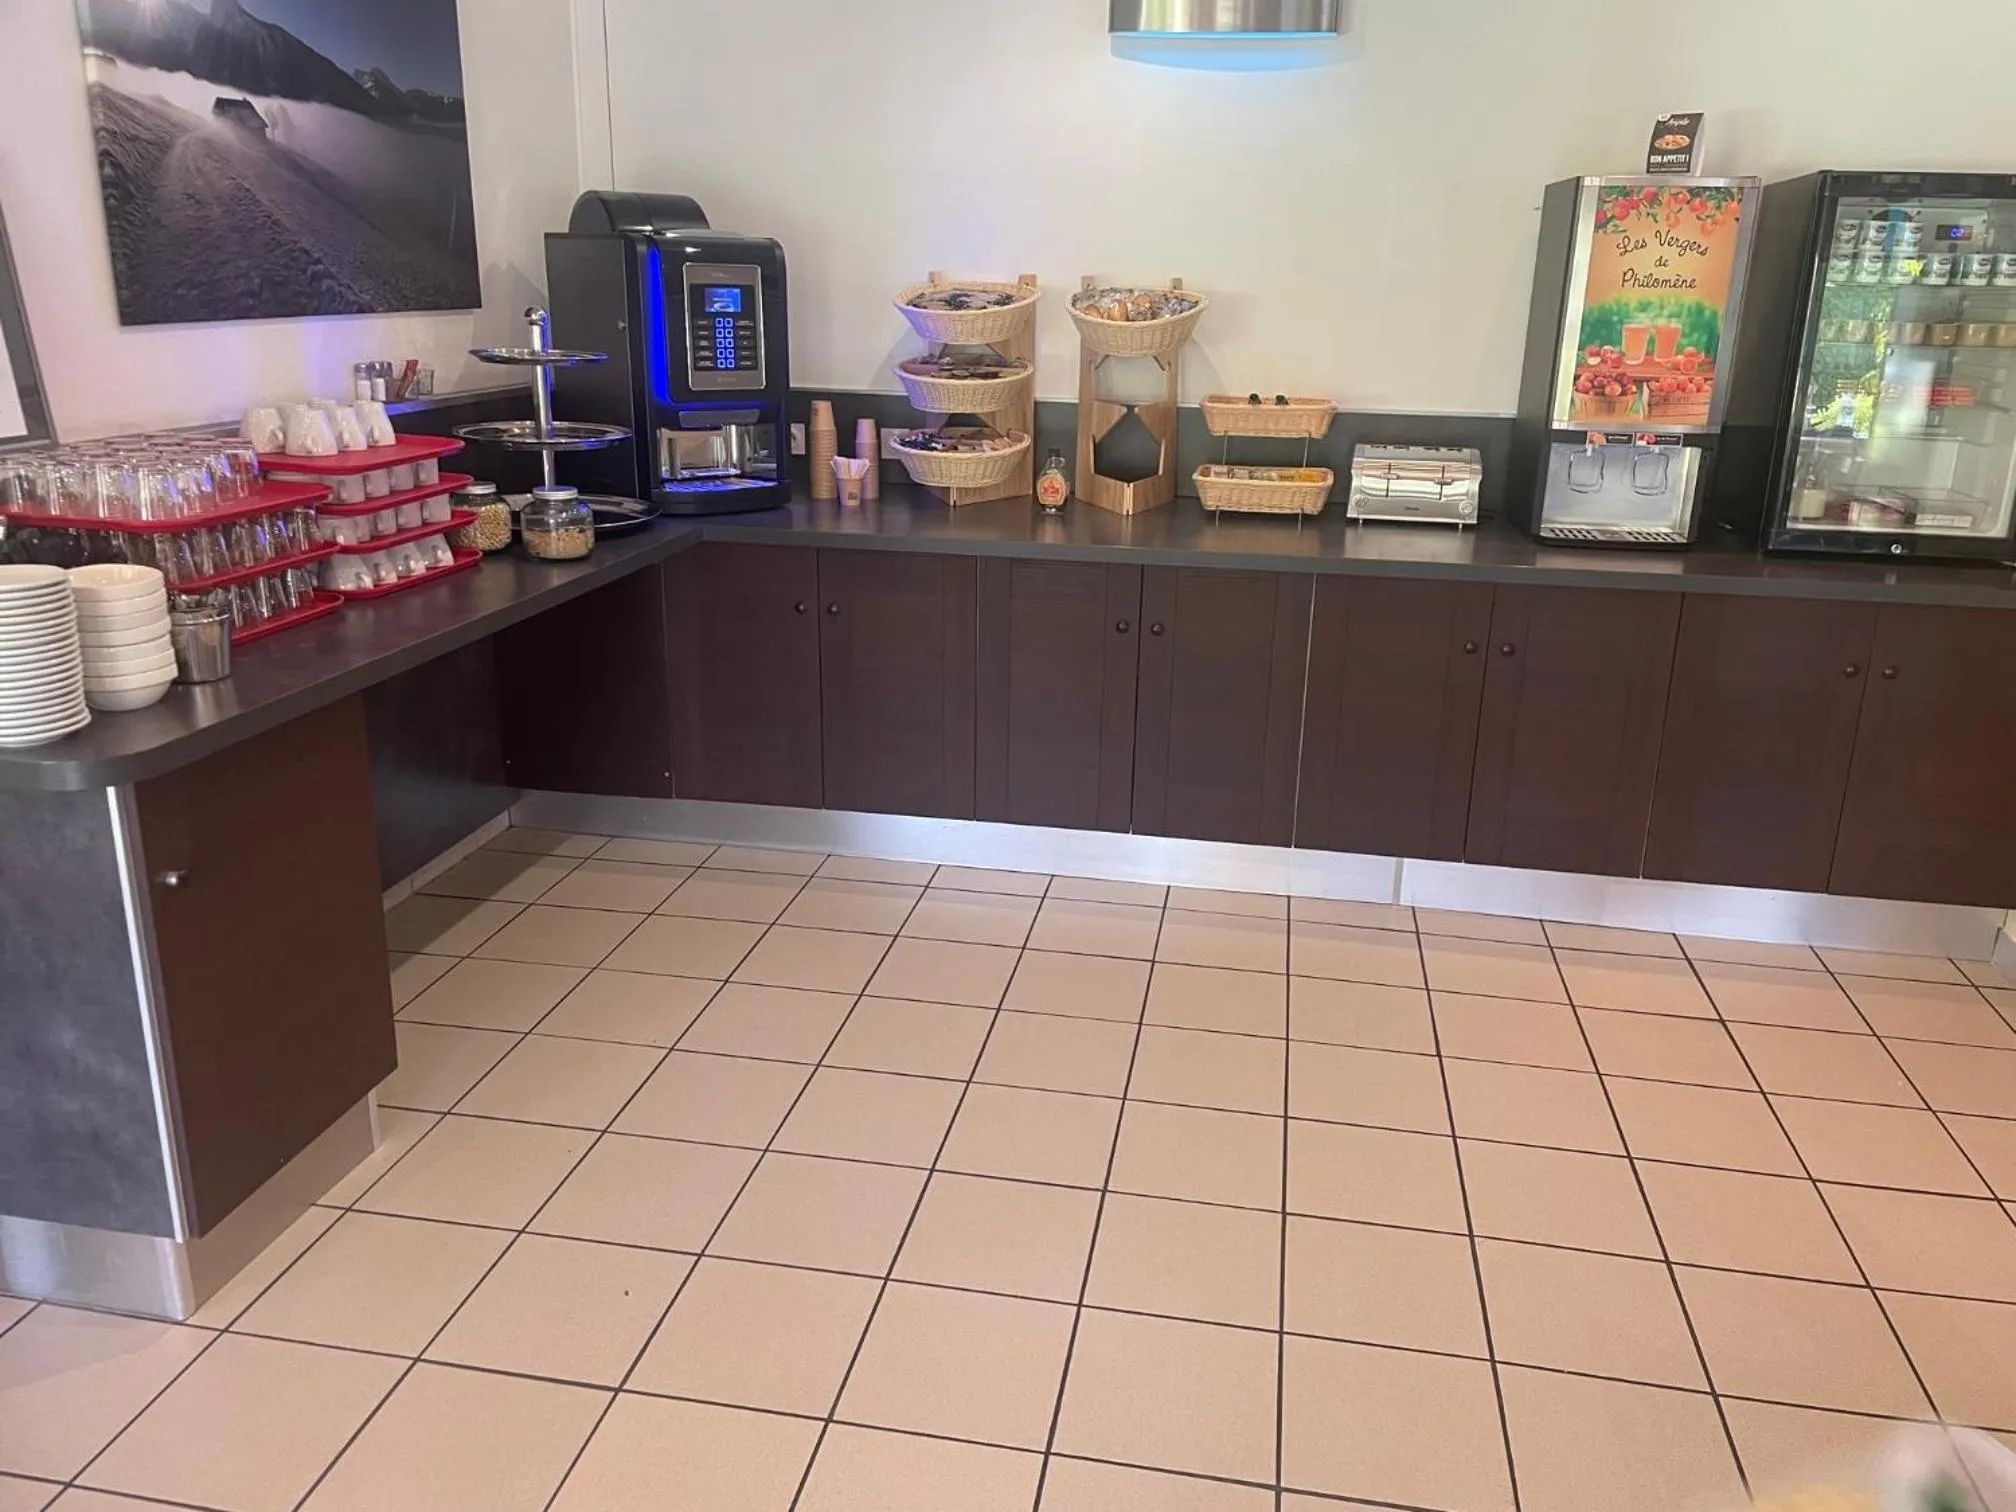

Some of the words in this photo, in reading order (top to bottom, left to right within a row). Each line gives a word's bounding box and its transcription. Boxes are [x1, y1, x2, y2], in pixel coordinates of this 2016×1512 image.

[1616, 234, 1647, 257] Les
[1654, 228, 1709, 257] Vergers
[1654, 255, 1669, 268] de
[1621, 267, 1697, 289] Philomène
